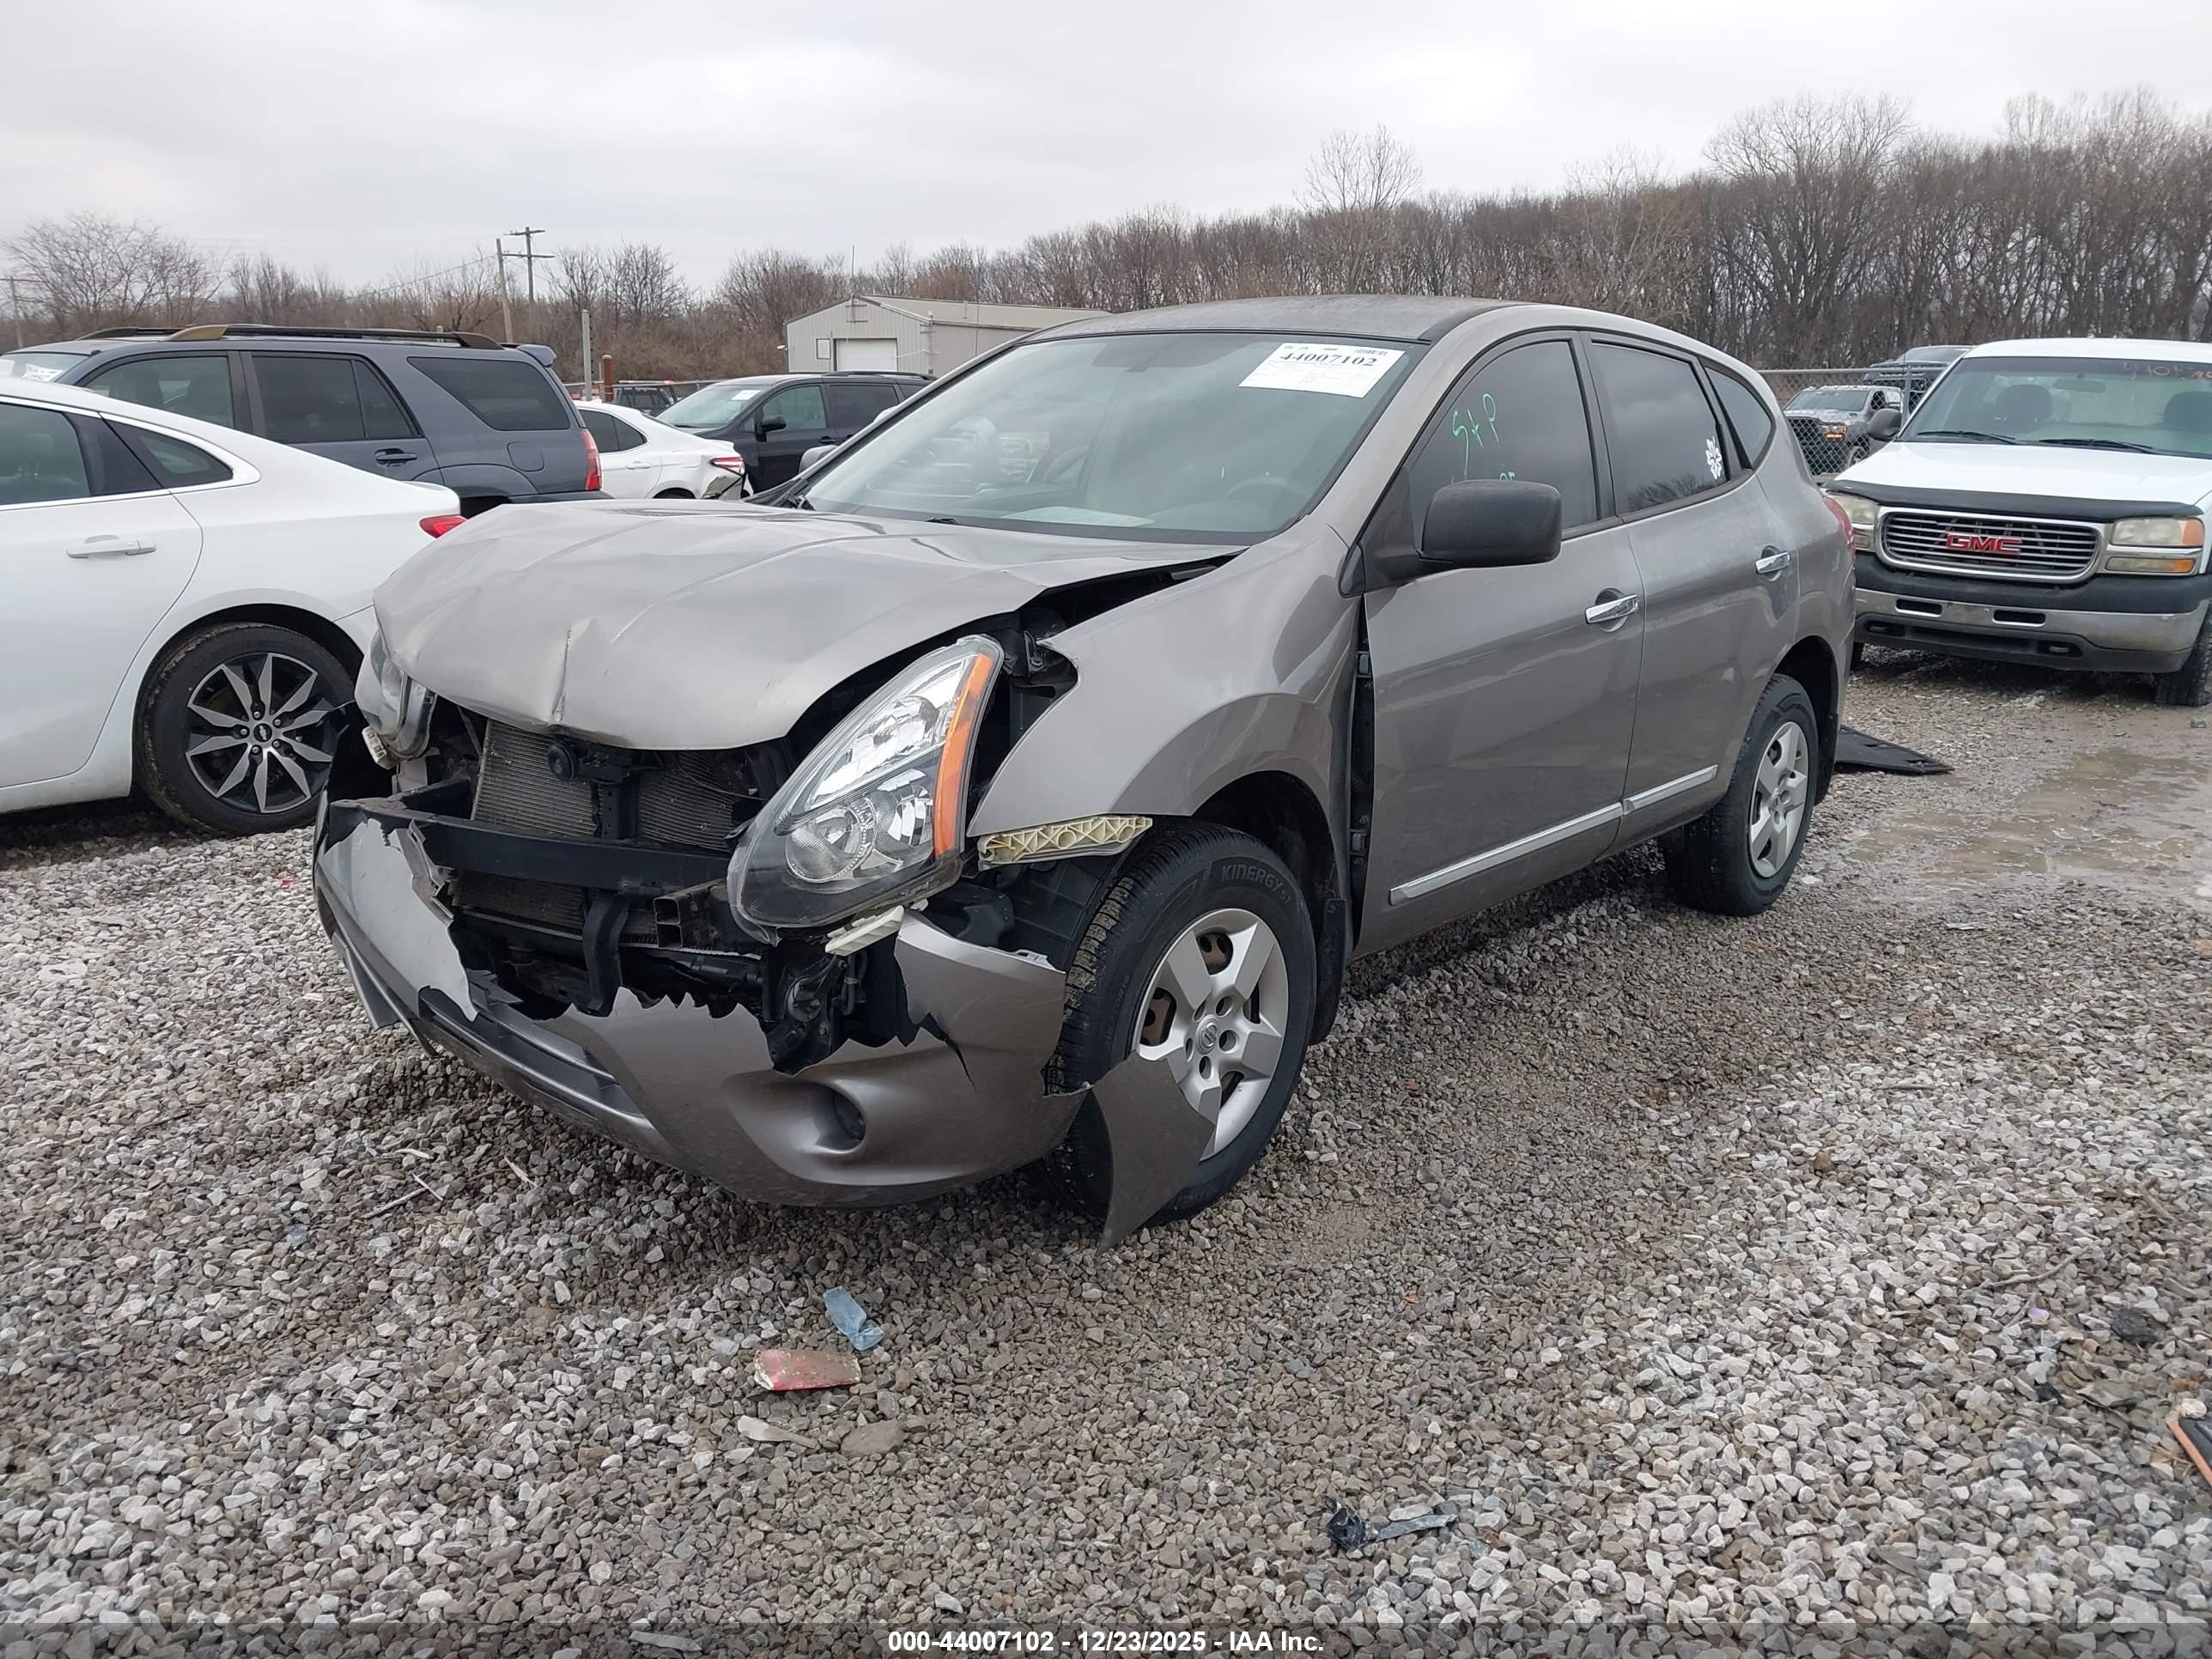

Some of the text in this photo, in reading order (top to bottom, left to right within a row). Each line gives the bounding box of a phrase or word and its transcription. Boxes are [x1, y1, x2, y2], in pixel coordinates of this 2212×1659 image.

[1279, 352, 1378, 367] 44007102
[1946, 532, 2023, 555] GMC
[1221, 863, 1284, 892] KINERGY
